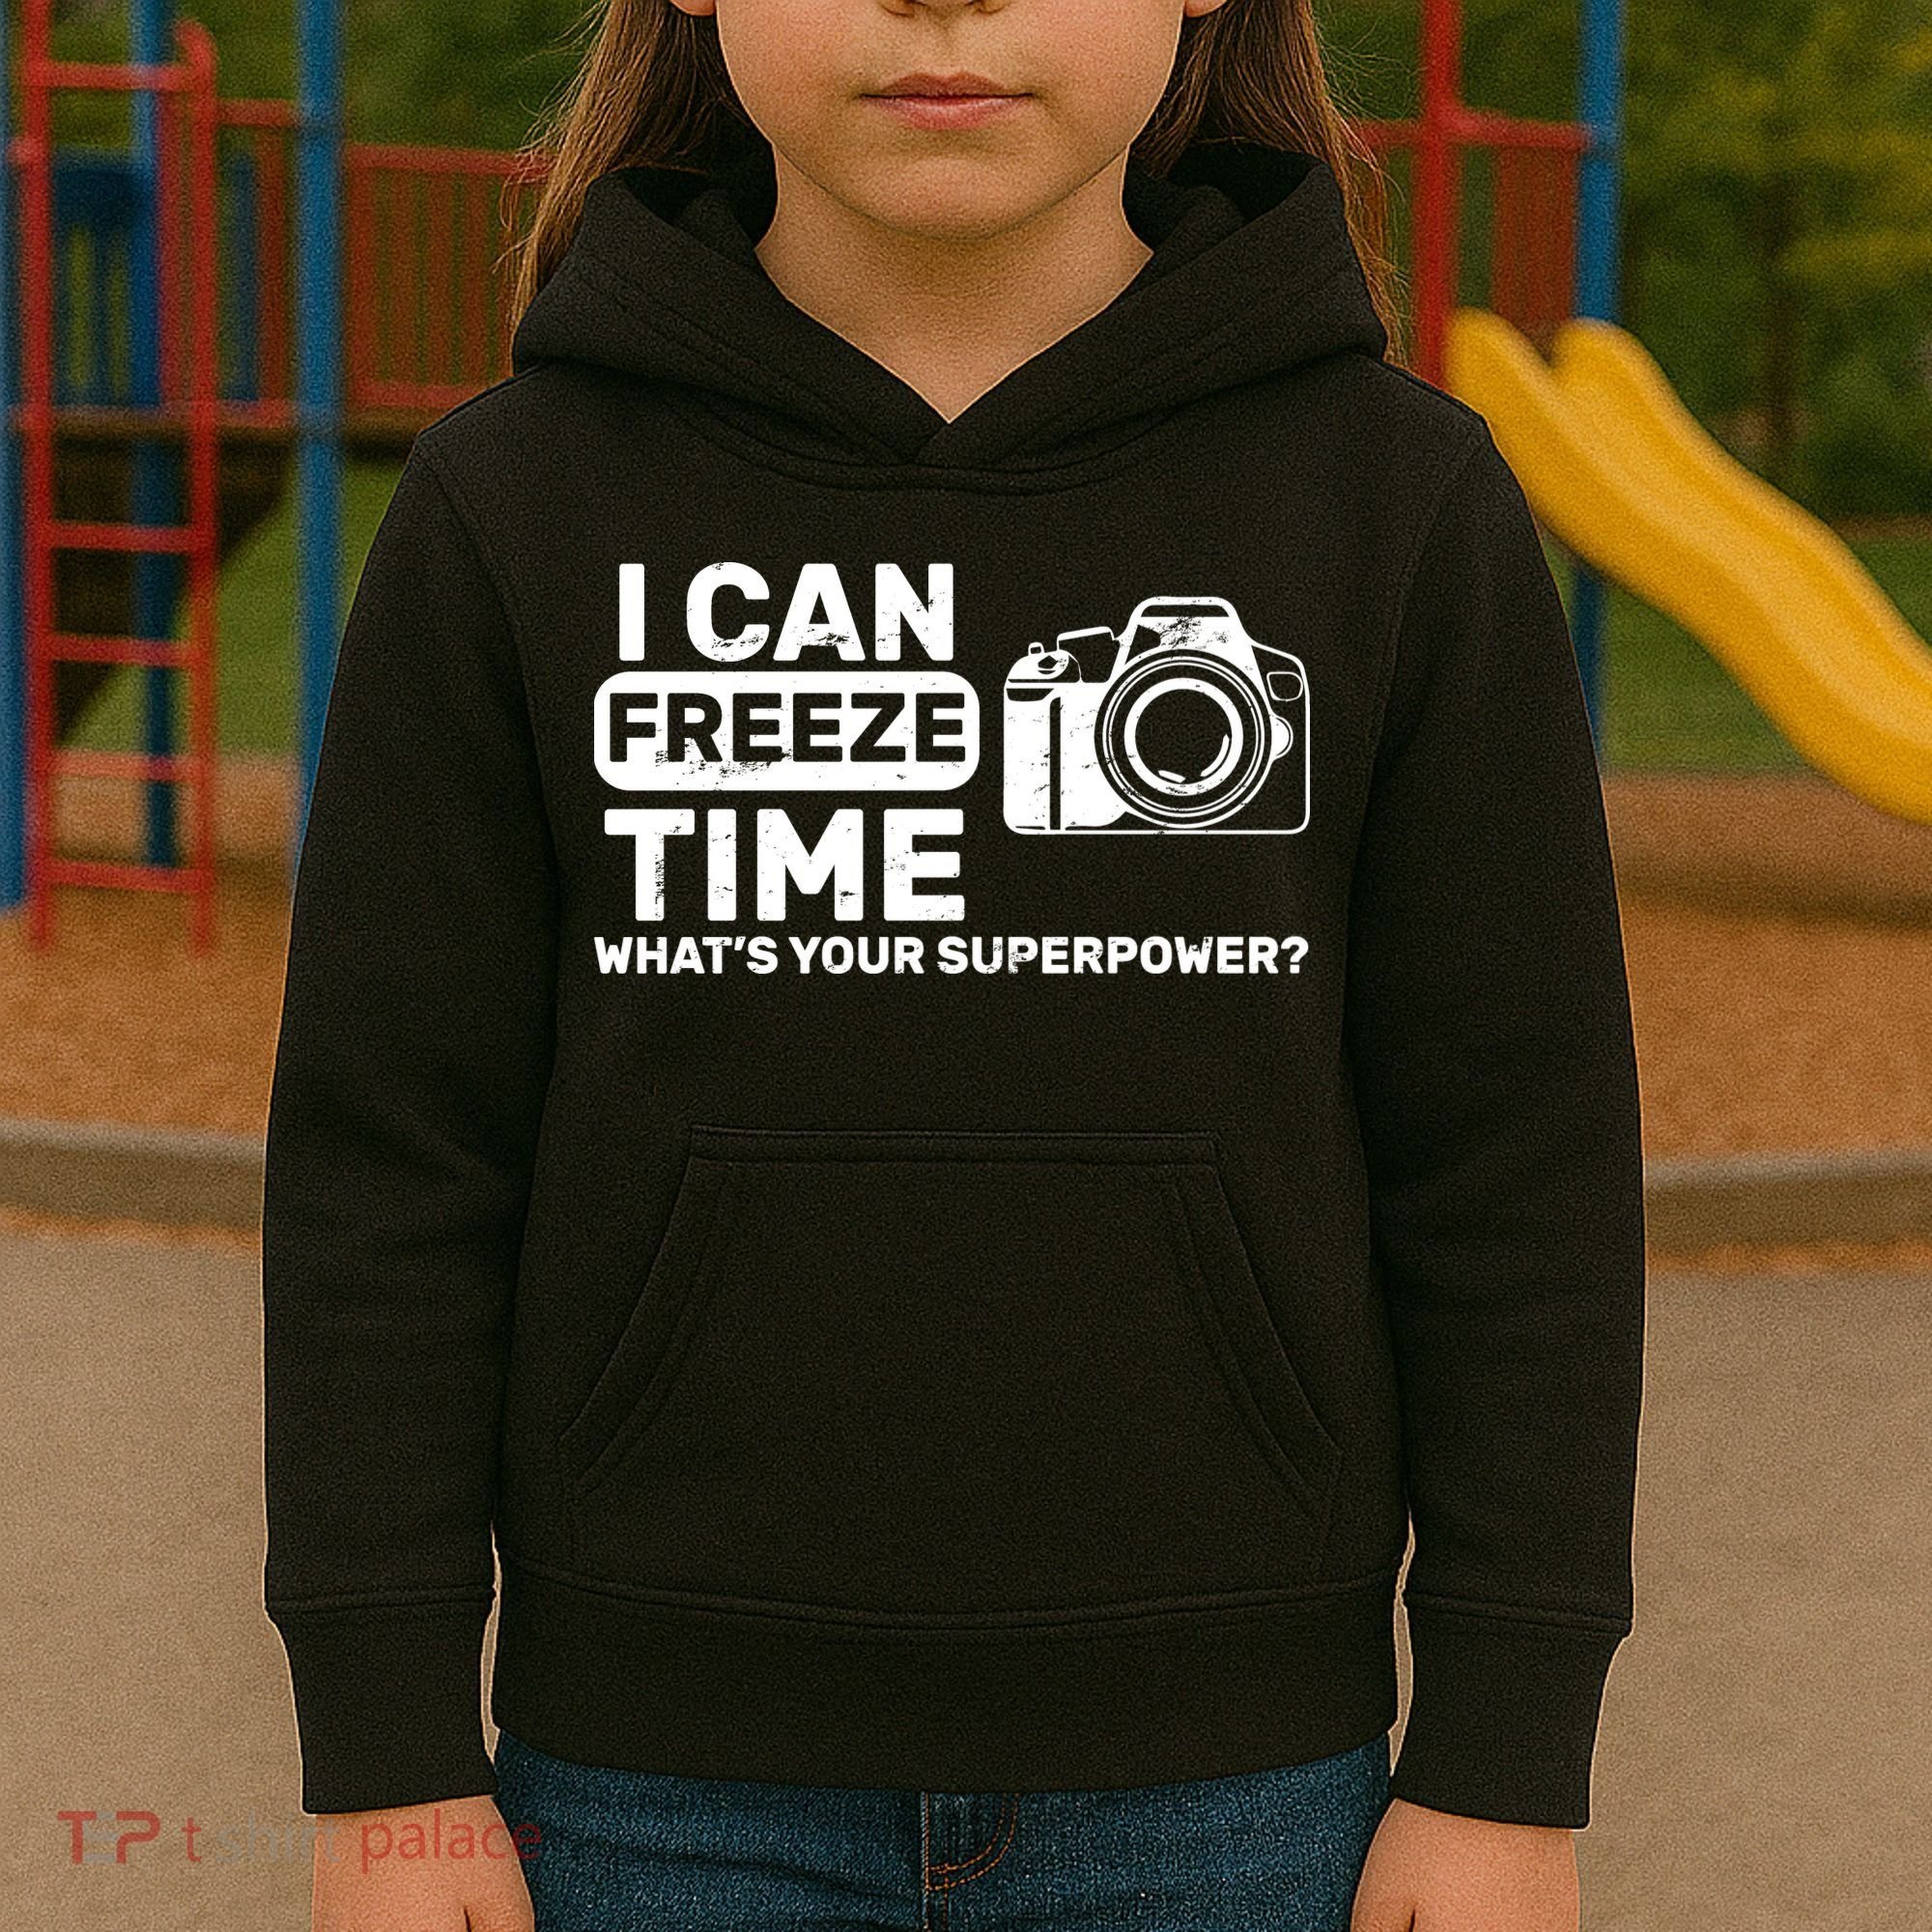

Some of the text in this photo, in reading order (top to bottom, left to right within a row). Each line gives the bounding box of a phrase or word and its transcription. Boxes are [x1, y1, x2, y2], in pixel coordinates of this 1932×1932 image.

[619, 562, 954, 662] I CAN
[609, 693, 966, 762] FREEZE
[605, 809, 965, 922] TIME
[594, 936, 1309, 974] WHAT'S YOUR SUPERPOWER?
